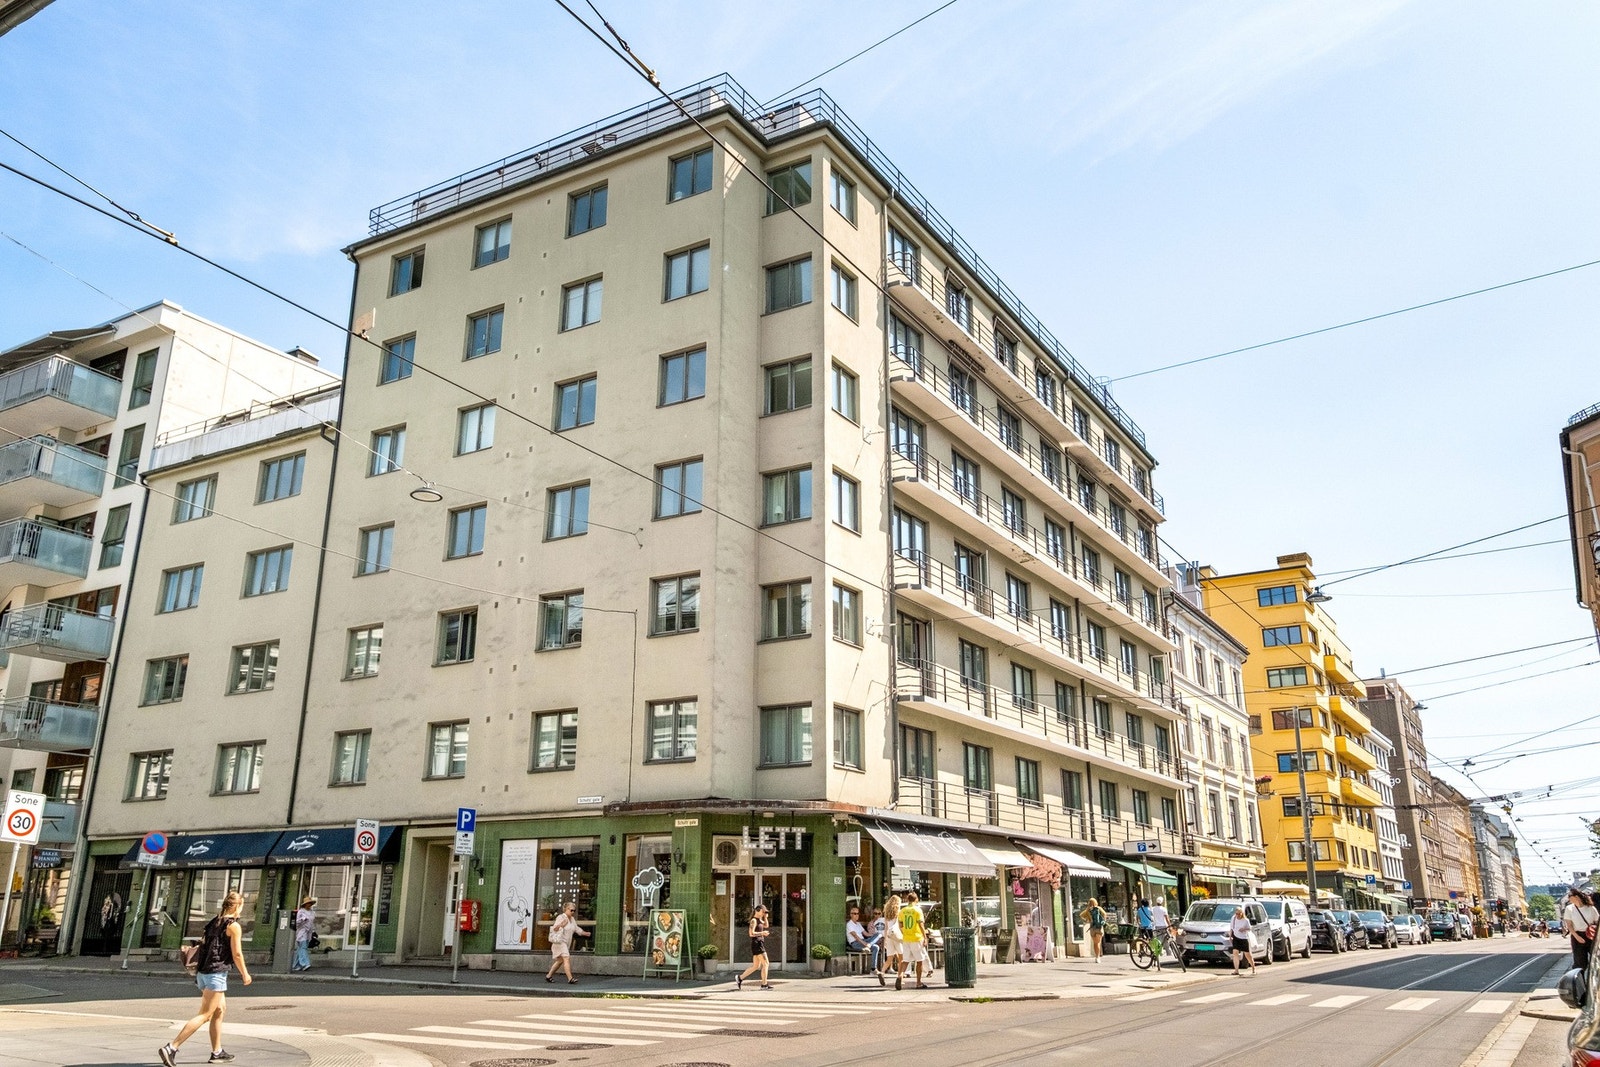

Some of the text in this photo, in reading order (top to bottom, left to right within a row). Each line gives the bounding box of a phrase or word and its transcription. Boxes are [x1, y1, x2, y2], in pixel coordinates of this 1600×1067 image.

[15, 794, 38, 806] Sone
[12, 815, 31, 830] 30
[360, 820, 376, 829] Sone
[461, 810, 472, 829] P
[361, 836, 373, 847] 30
[742, 825, 806, 850] LETT
[1367, 875, 1373, 883] P
[904, 915, 914, 930] 10
